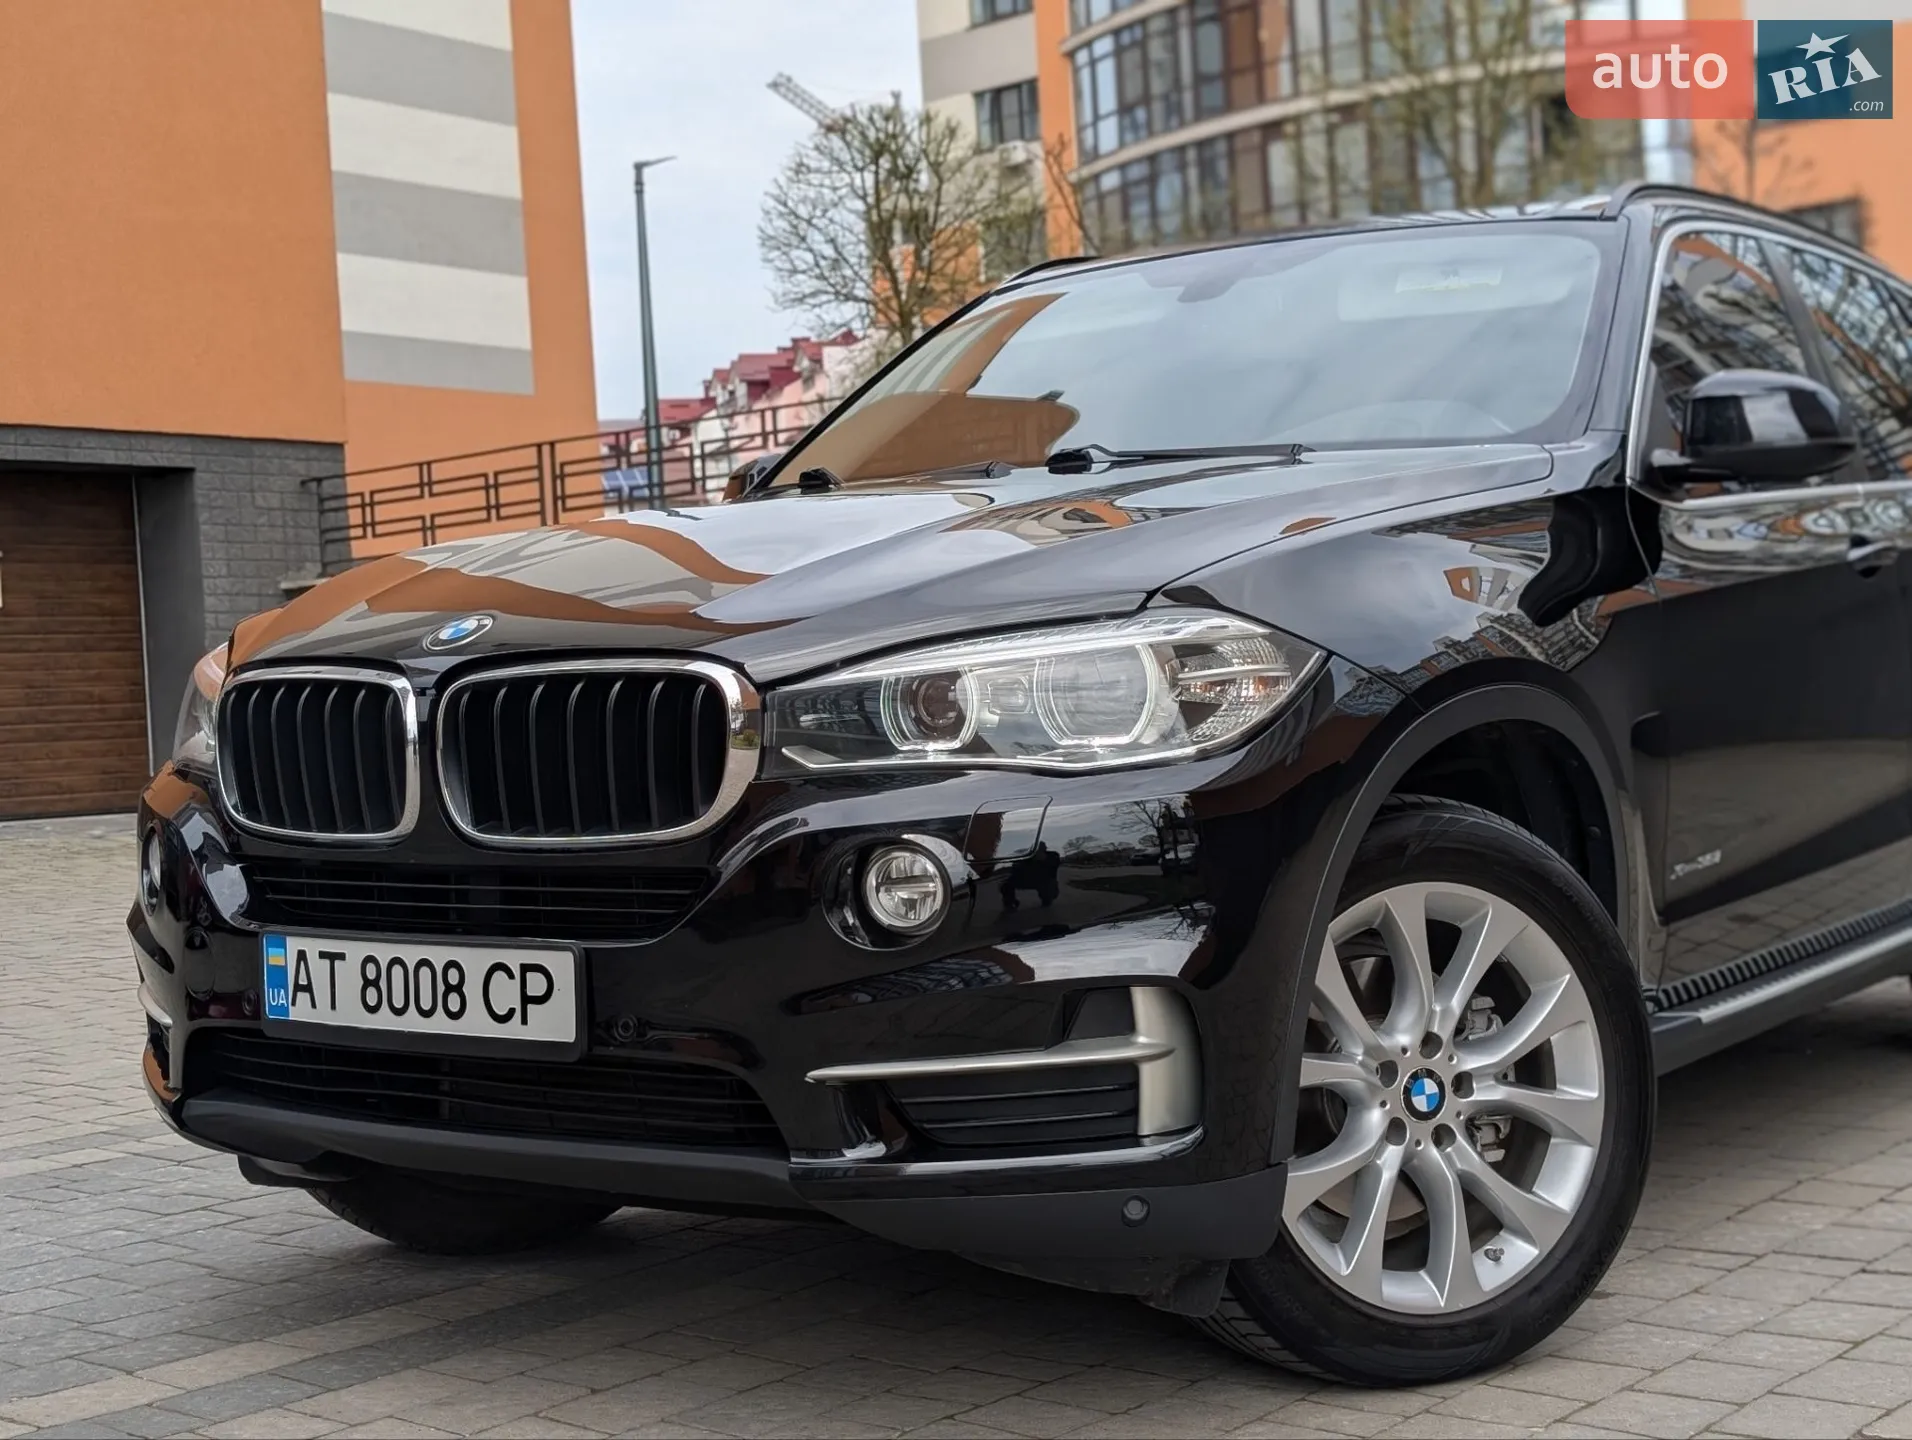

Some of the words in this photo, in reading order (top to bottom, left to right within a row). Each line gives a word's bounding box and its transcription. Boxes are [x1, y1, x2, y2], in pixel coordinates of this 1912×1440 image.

[269, 988, 288, 1007] UA
[291, 949, 346, 1011] AT
[360, 954, 467, 1020] 8008
[482, 961, 555, 1026] CP
